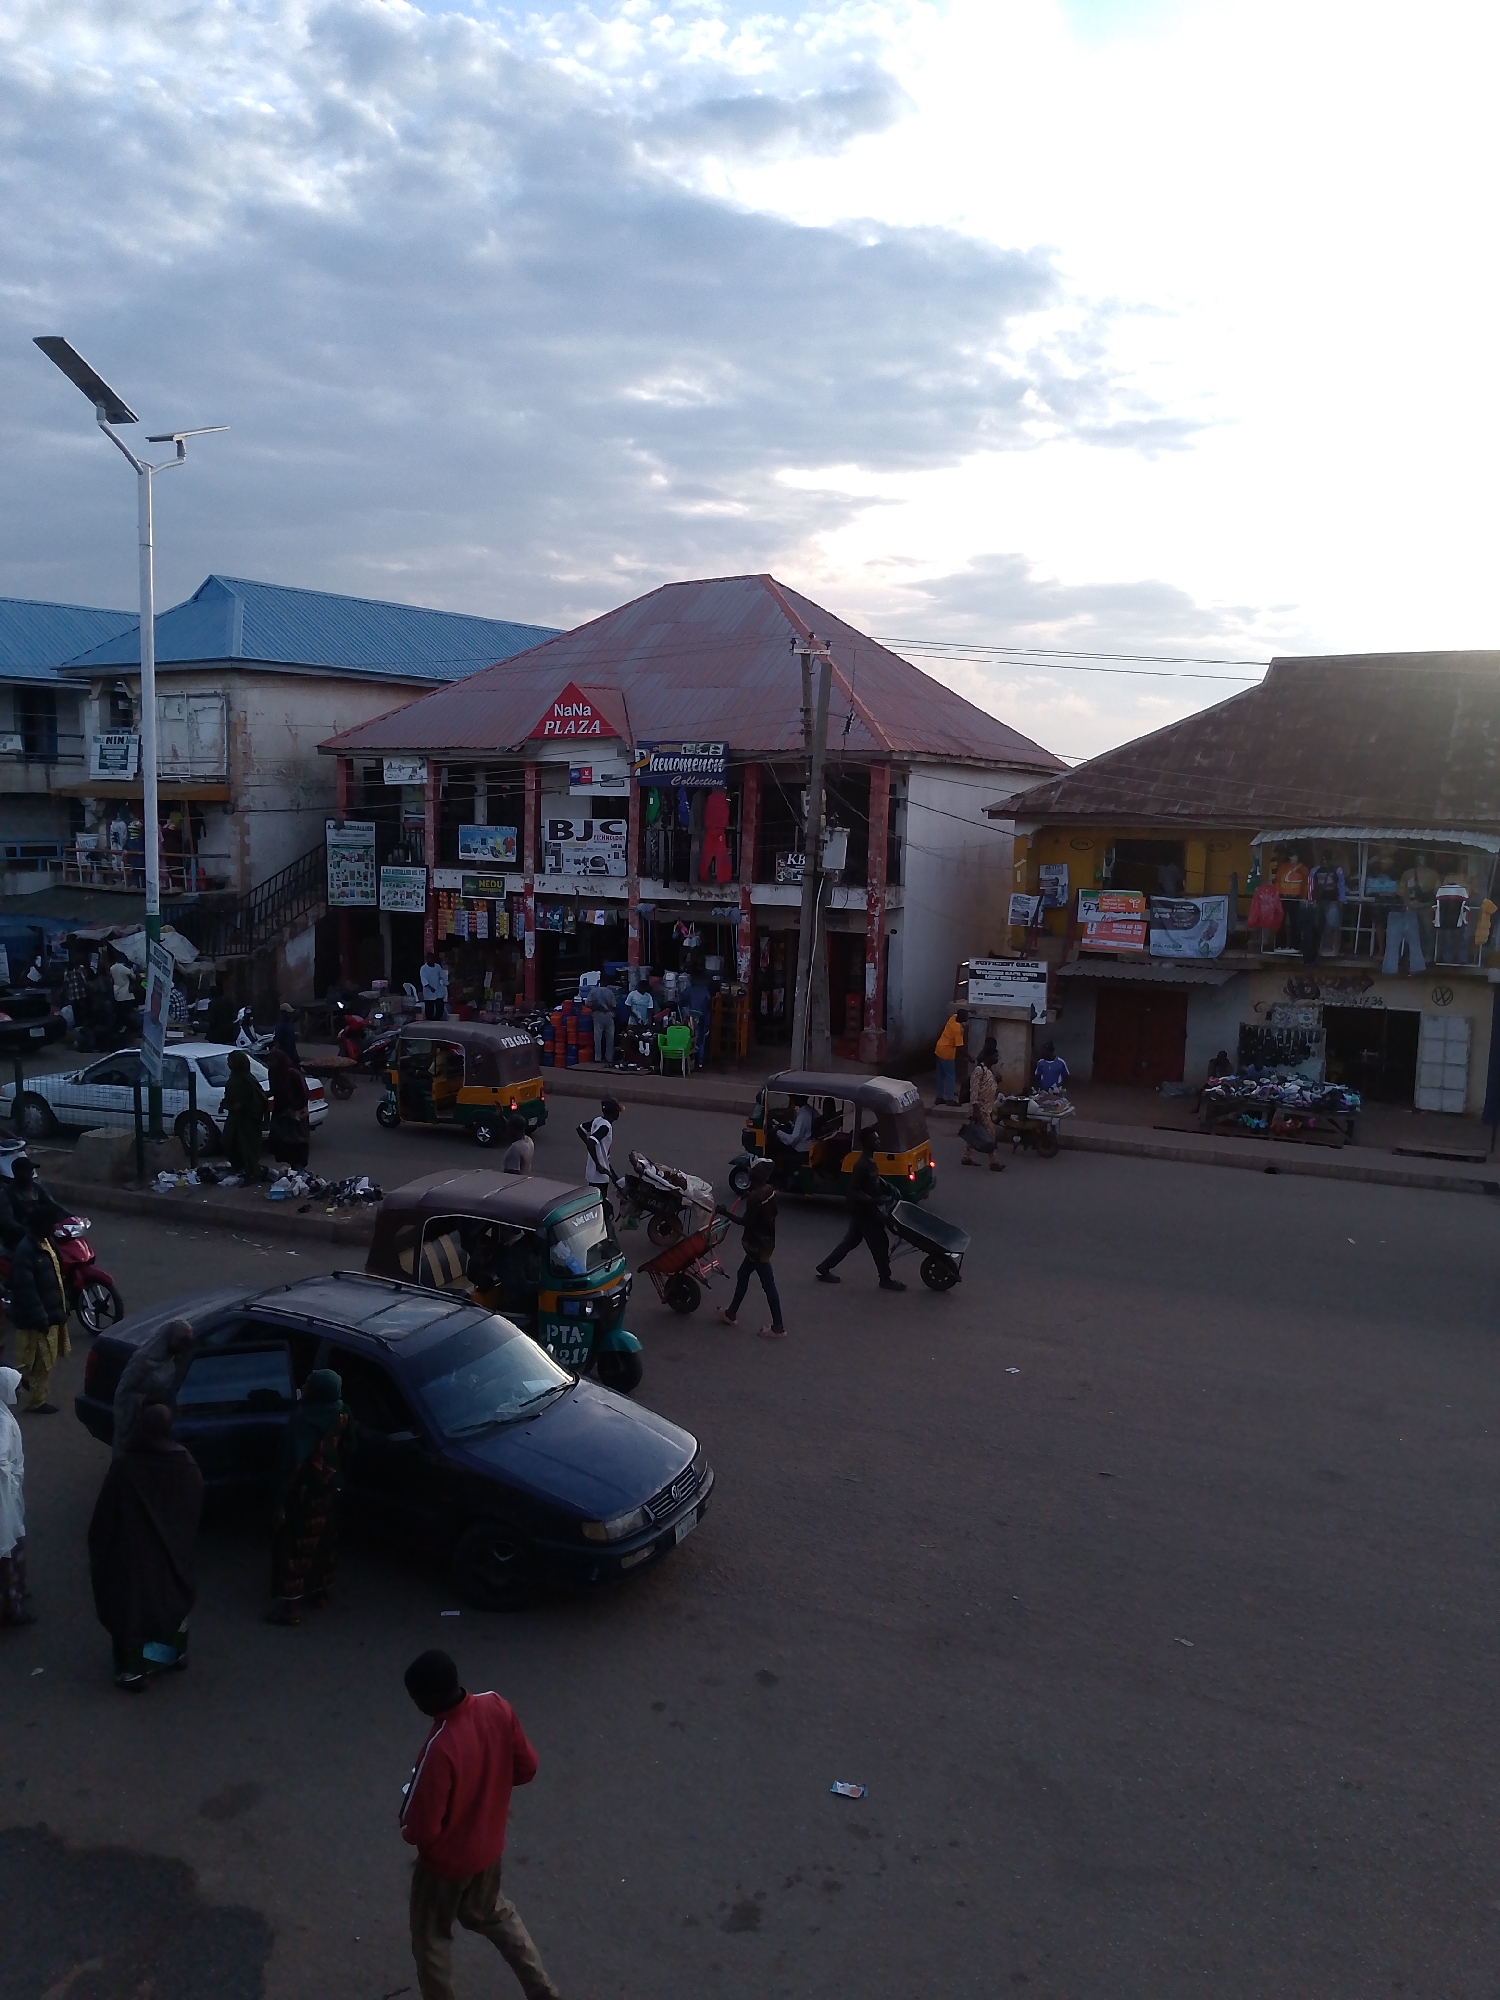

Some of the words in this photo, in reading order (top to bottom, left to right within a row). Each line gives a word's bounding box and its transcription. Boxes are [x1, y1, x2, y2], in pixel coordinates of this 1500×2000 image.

[554, 702, 592, 717] NaNa
[543, 720, 601, 735] PLAZA
[105, 736, 125, 745] NIN
[671, 775, 724, 787] Collection
[549, 819, 623, 841] BJC
[478, 879, 503, 888] NEDU
